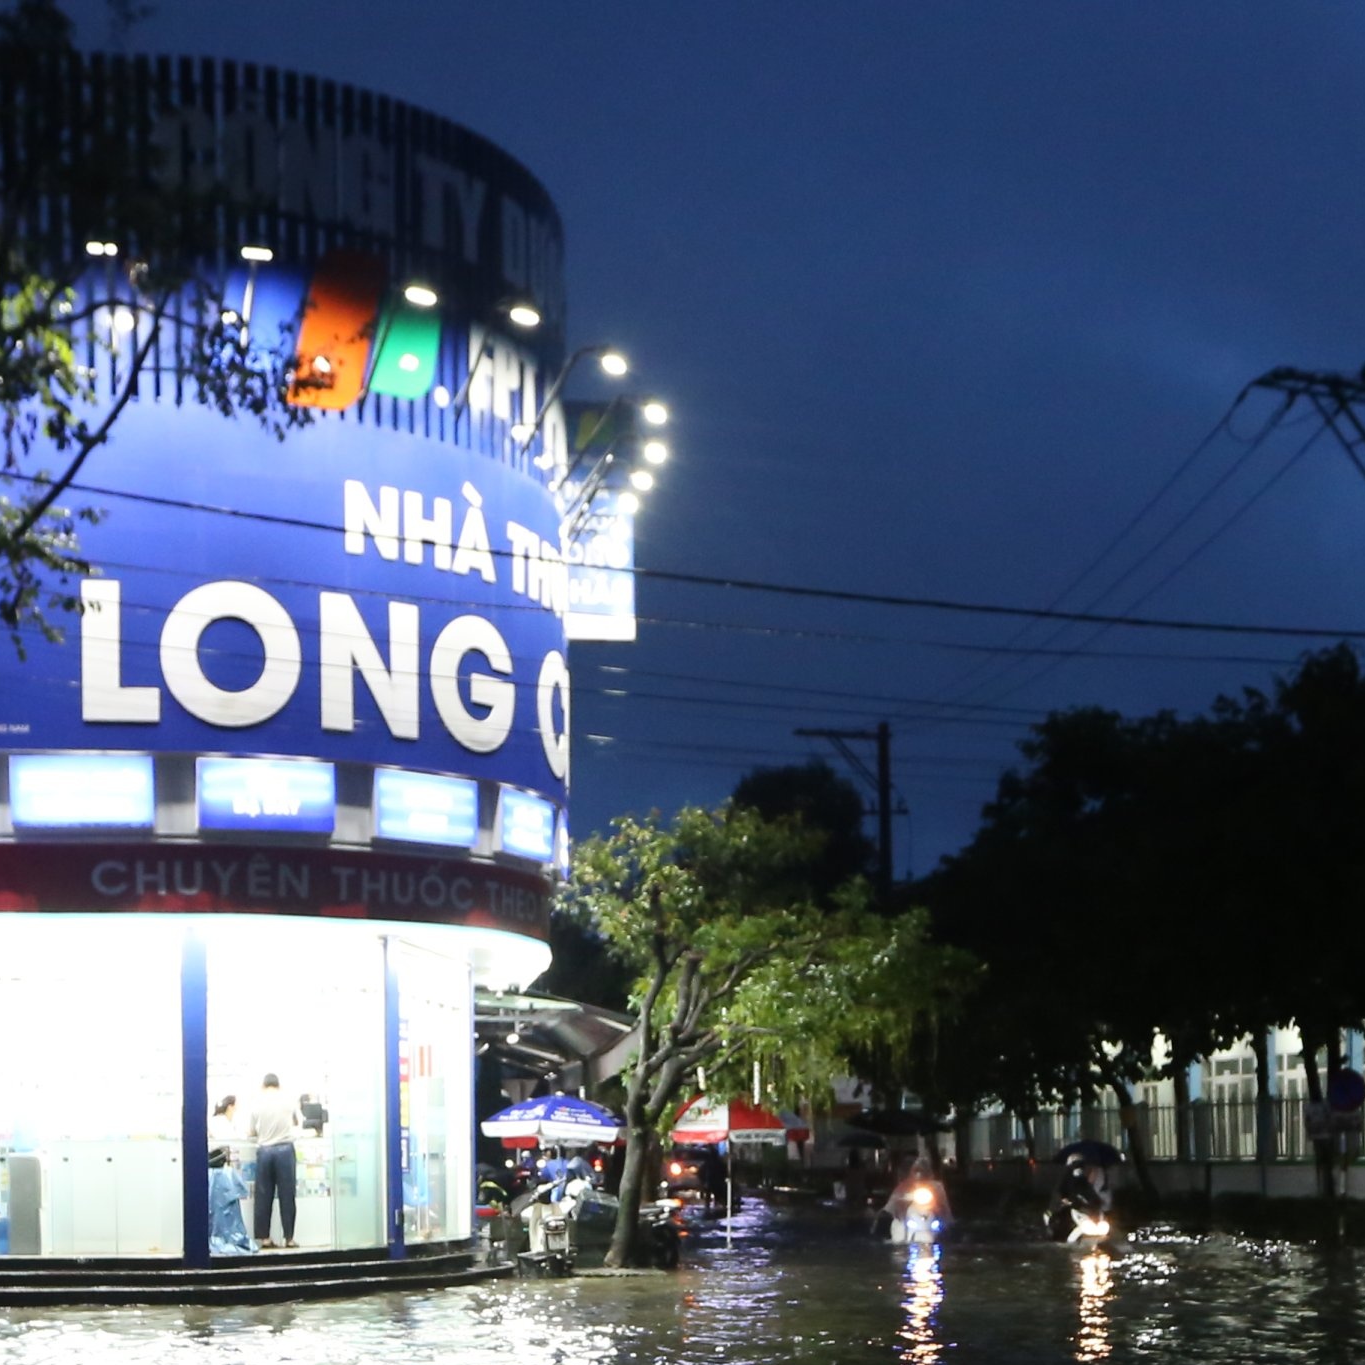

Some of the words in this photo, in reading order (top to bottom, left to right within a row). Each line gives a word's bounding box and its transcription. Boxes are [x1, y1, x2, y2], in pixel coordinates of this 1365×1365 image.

[344, 480, 495, 582] NHÀ
[82, 579, 514, 754] LONG
[92, 855, 310, 899] CHUYÊN
[332, 861, 474, 909] THUỐC
